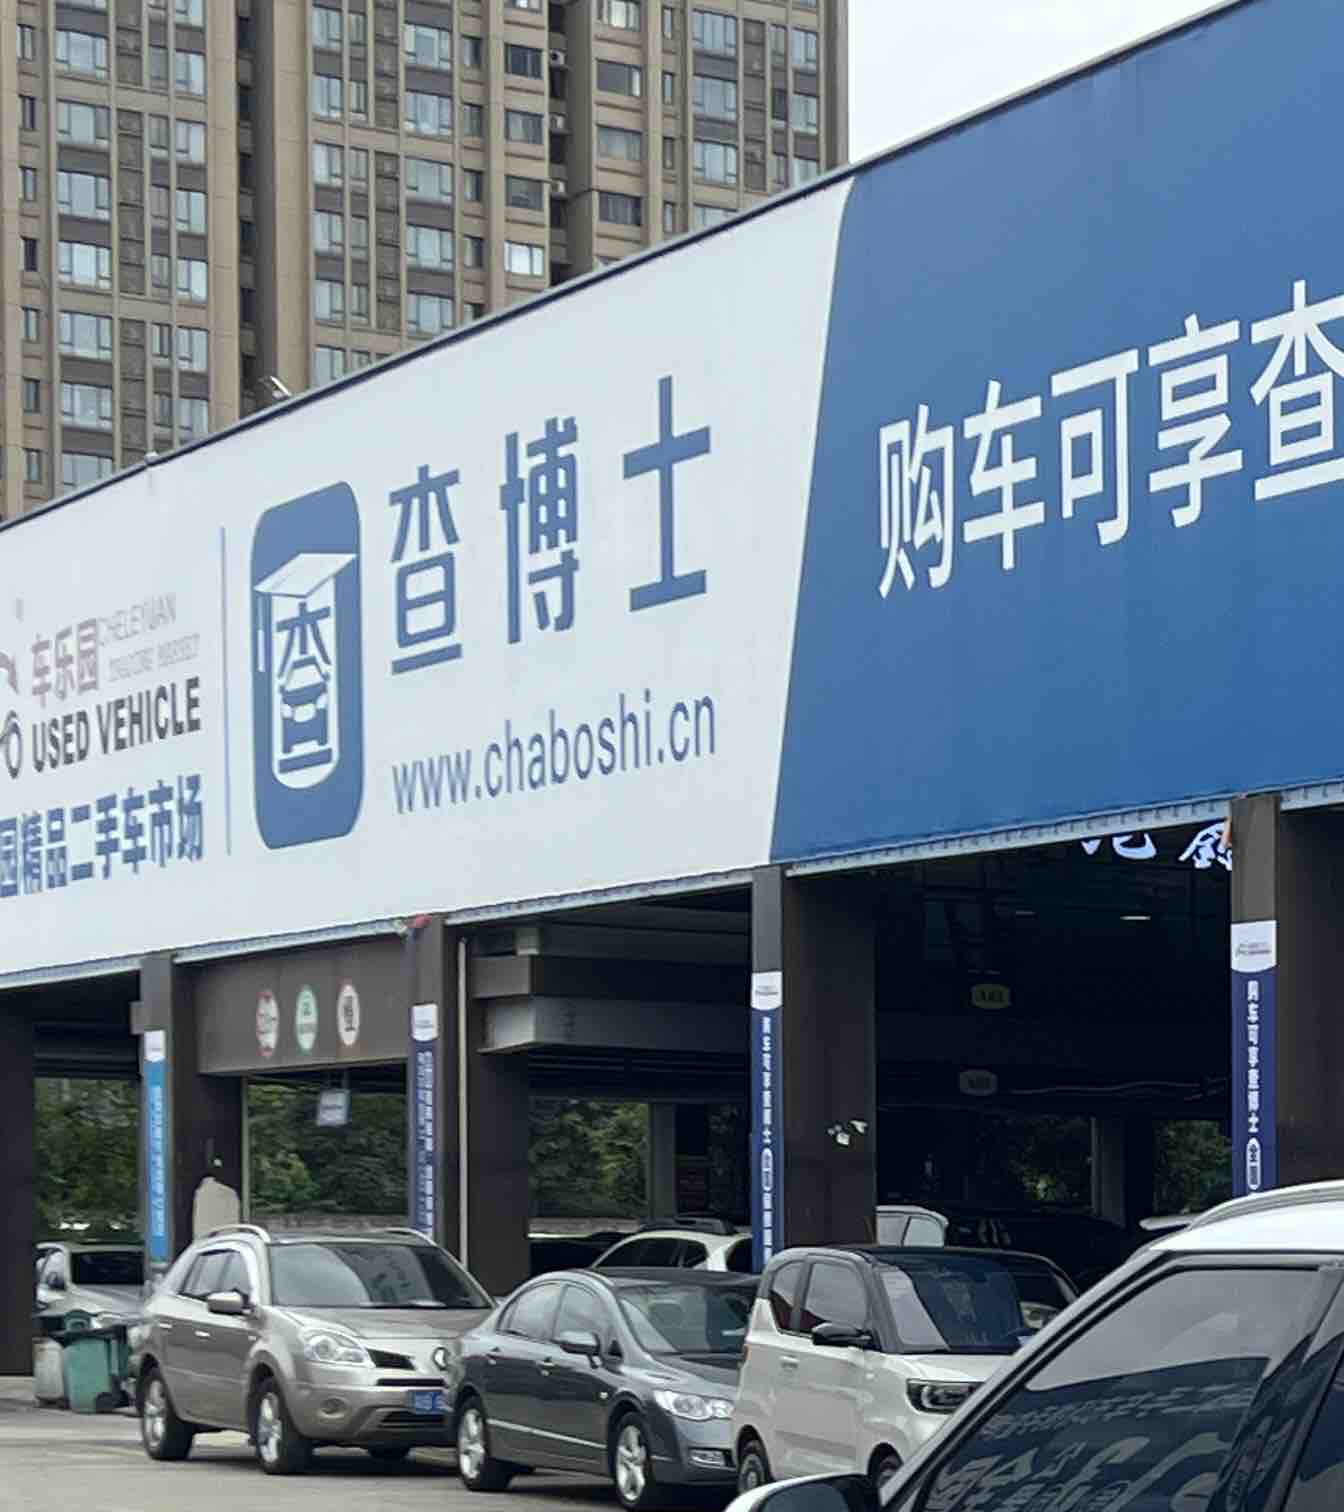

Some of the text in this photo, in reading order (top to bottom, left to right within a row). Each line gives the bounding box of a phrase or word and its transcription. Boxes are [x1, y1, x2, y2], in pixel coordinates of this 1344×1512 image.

[389, 375, 712, 675] 查博士
[31, 676, 201, 773] USED VEHICLE
[391, 689, 716, 815] www.chaboshi.cn
